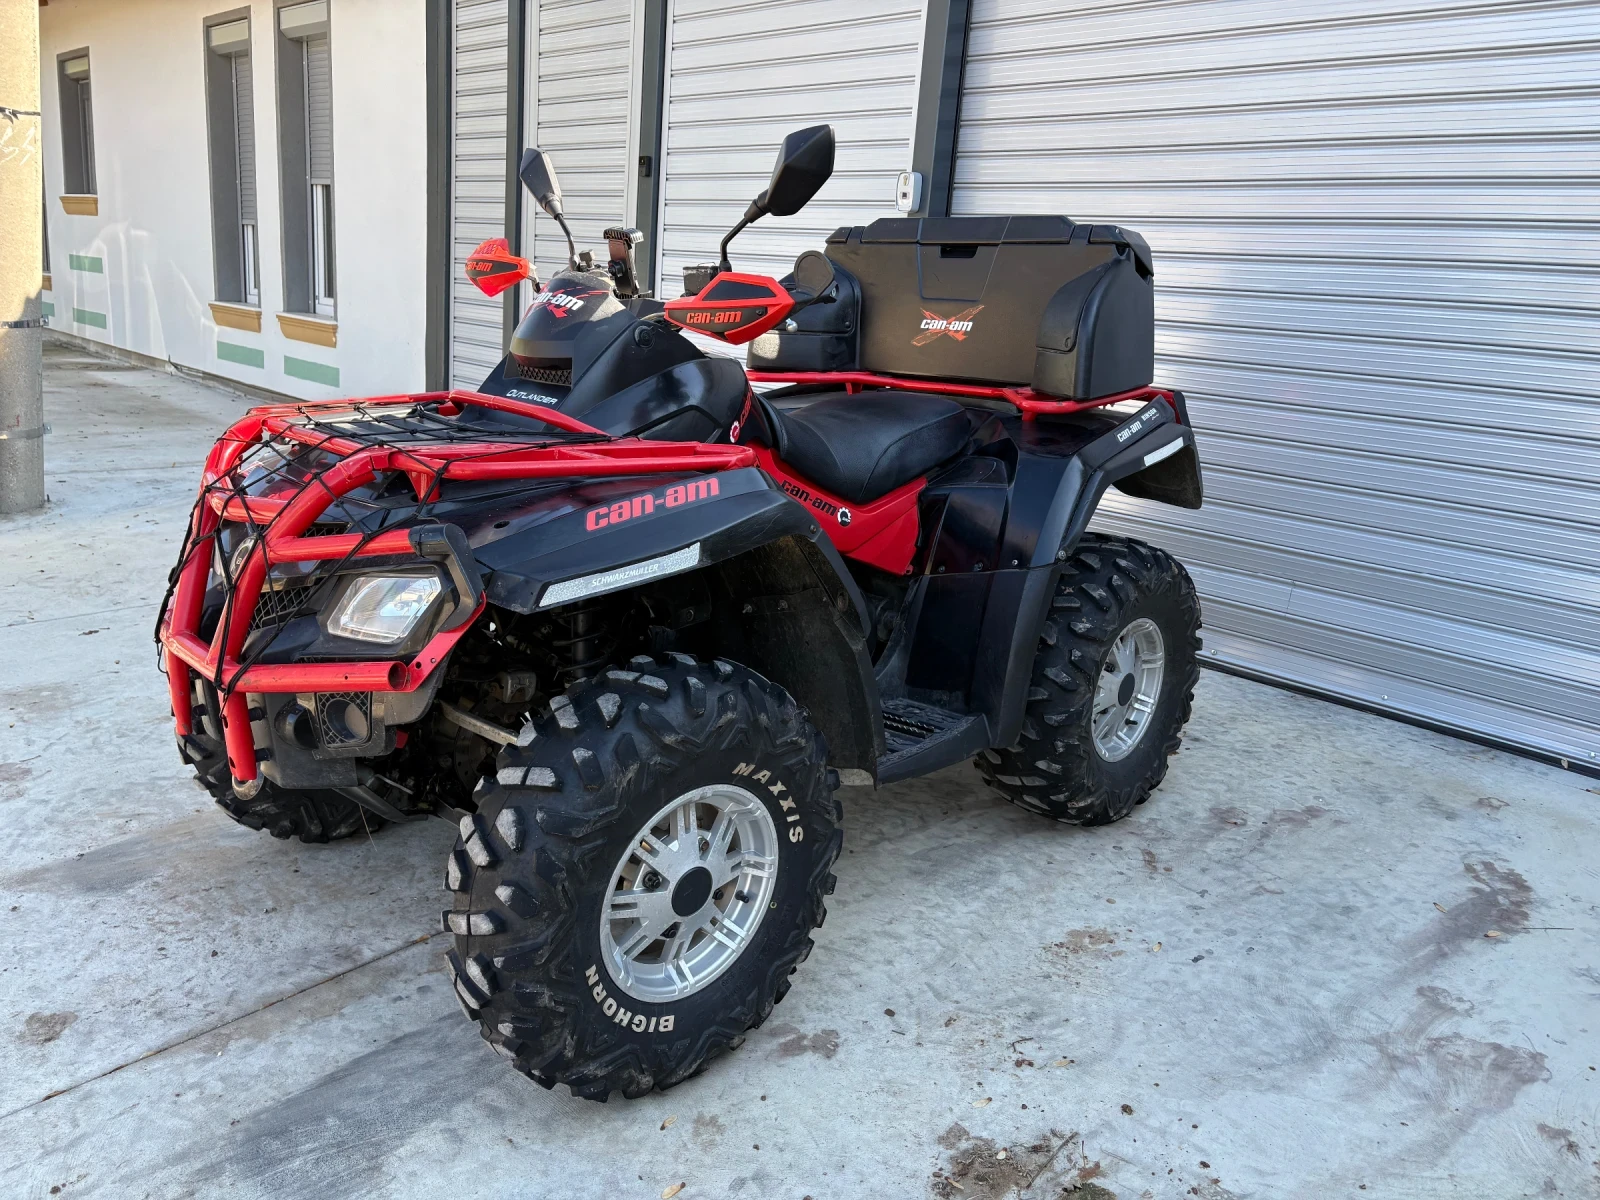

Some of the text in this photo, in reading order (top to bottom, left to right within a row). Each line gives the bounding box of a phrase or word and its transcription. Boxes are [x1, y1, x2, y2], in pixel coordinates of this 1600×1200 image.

[535, 291, 585, 311] an-am
[686, 310, 743, 324] can-am
[920, 318, 973, 332] can-am
[505, 388, 558, 405] OUTLANDER
[1116, 420, 1143, 443] can-am
[586, 477, 720, 531] can-am
[780, 479, 838, 517] can-am
[731, 762, 804, 843] MAXXIS
[585, 963, 675, 1033] BIGHORN
